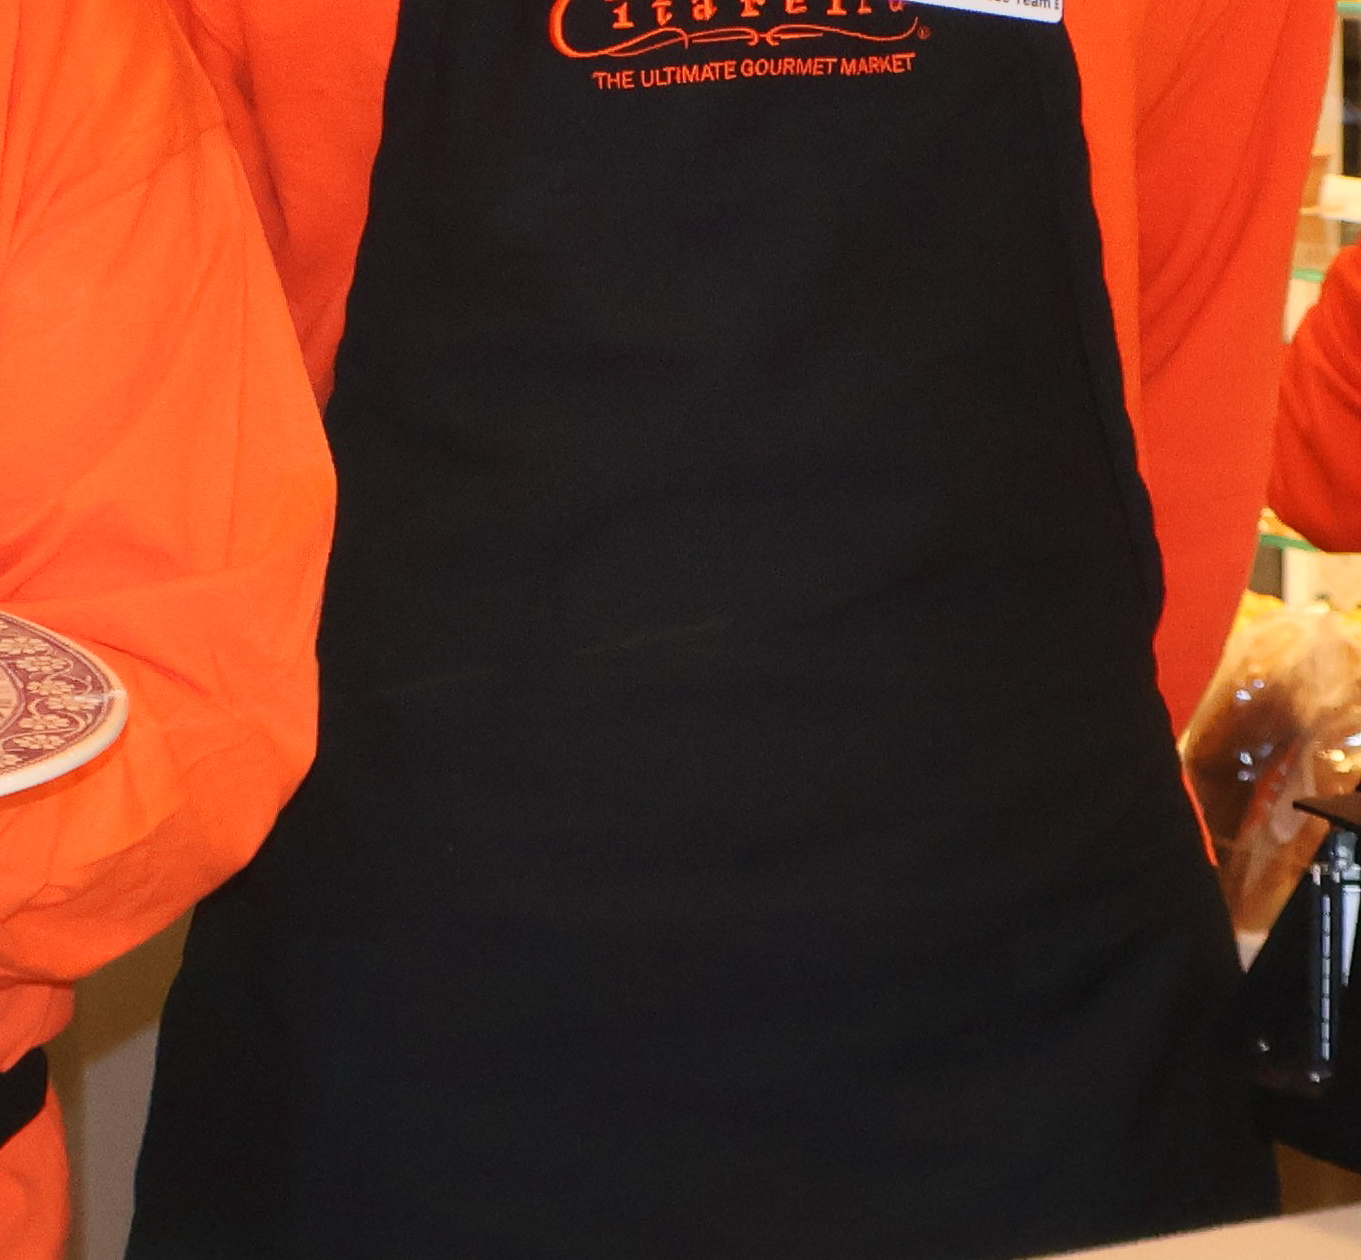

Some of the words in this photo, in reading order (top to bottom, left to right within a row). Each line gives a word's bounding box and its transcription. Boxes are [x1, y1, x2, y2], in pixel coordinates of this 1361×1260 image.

[592, 69, 635, 91] THE
[640, 59, 738, 89] ULTIMATE
[740, 57, 838, 77] GOURMET
[840, 52, 917, 76] MARKET
